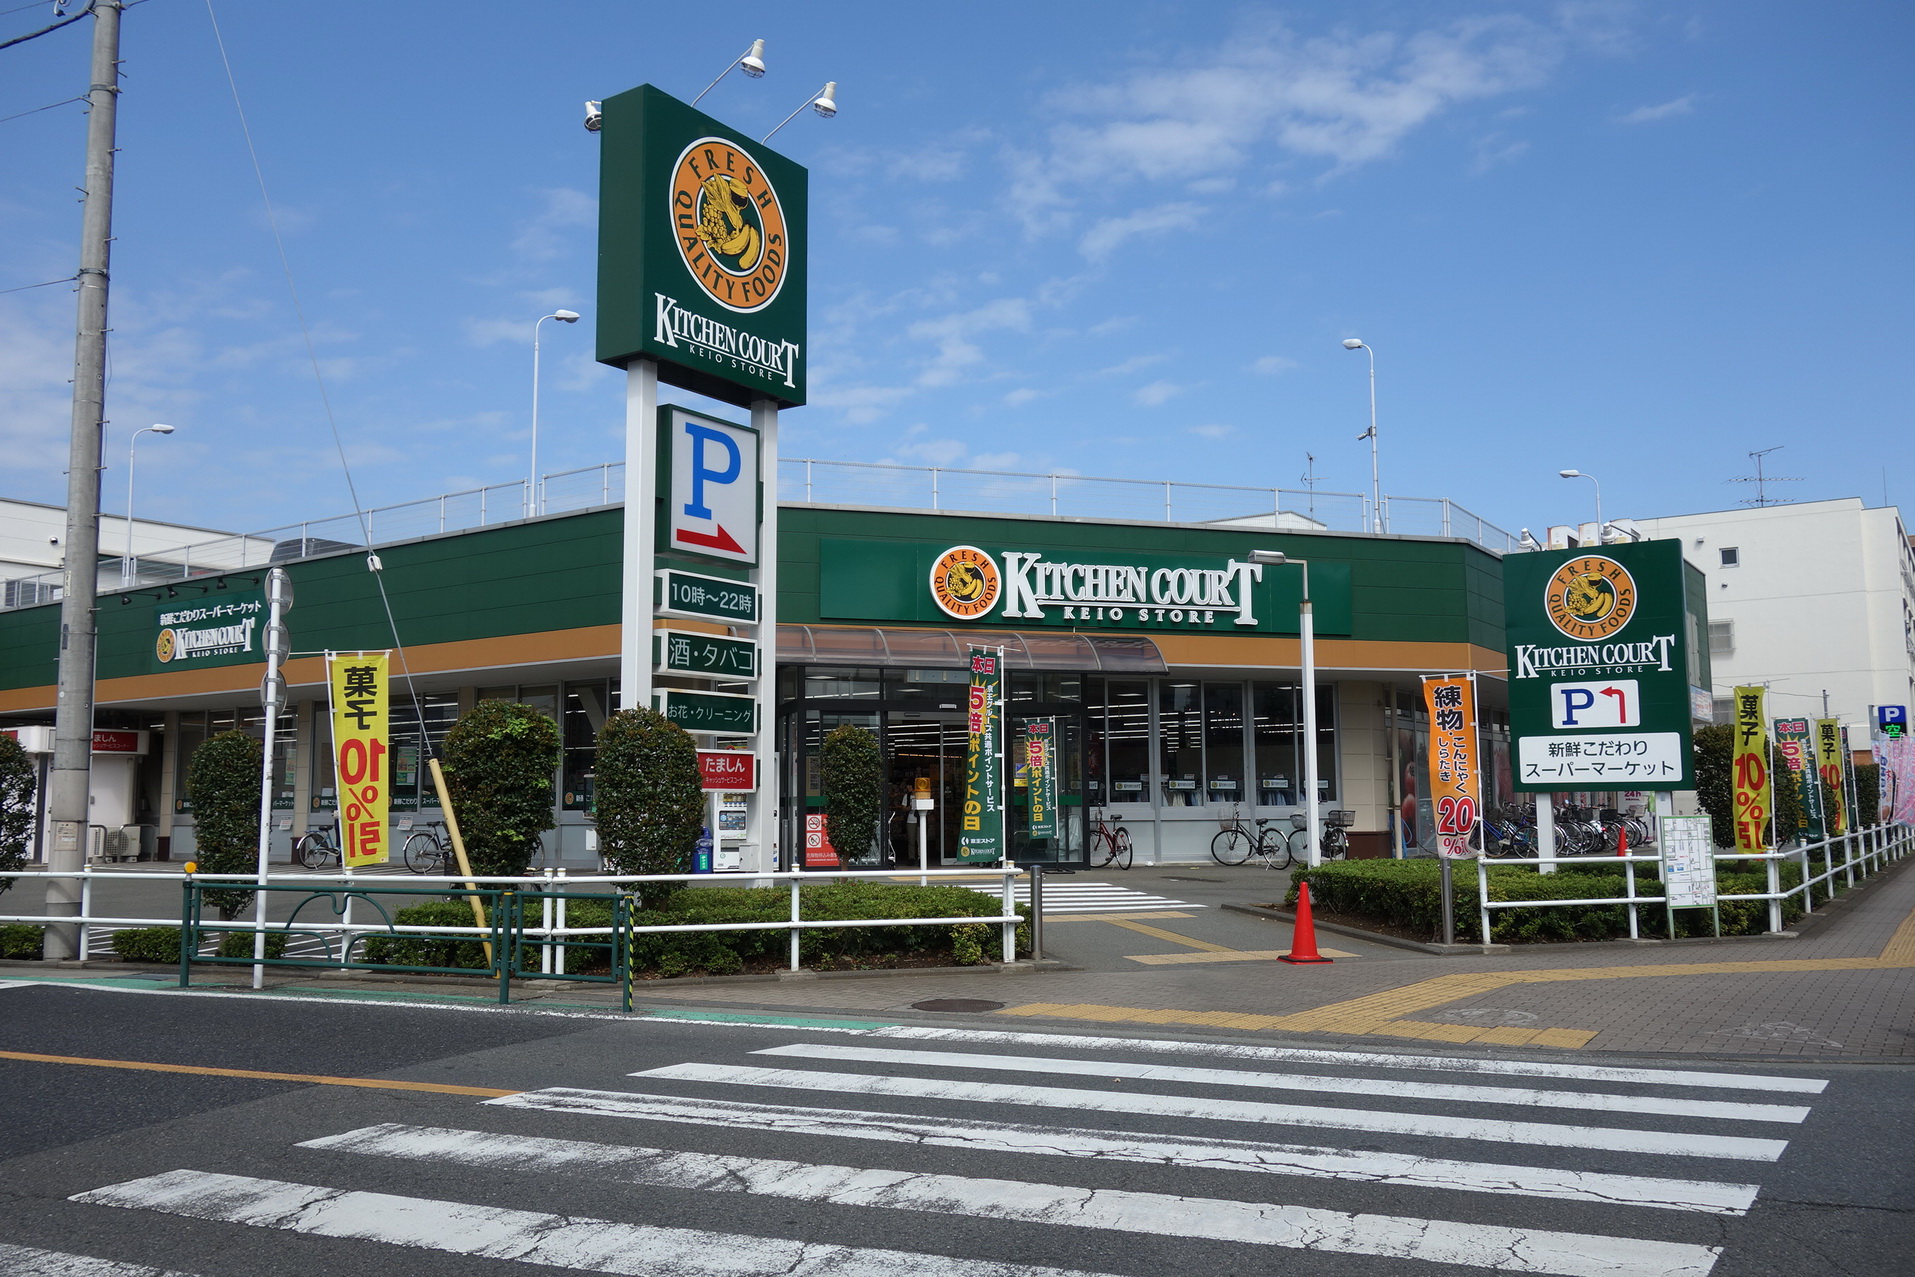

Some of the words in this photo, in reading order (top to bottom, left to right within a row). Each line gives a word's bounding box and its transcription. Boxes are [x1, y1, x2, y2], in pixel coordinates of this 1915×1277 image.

[689, 149, 772, 209] FRESH
[675, 190, 733, 300] QUALITY
[742, 233, 782, 303] FOODS
[653, 292, 739, 353] KITCHEN
[738, 330, 799, 389] COURT
[689, 344, 723, 364] KEIO
[731, 358, 773, 381] STORE
[683, 421, 741, 521] P
[940, 550, 990, 570] FRESH
[1557, 560, 1621, 585] FRESH
[934, 576, 970, 615] QUALITY
[973, 576, 997, 614] FOODS
[1000, 551, 1149, 619] KITCHEN
[1150, 557, 1263, 626] COURT
[1063, 606, 1124, 622] KEIO
[1138, 608, 1215, 624] STORE
[1547, 593, 1596, 637] QUALITY
[1600, 588, 1632, 634] FOODS
[174, 628, 218, 660] KITCHEN
[217, 617, 256, 652] COURT
[191, 650, 211, 658] KEIO
[213, 647, 239, 656] STORE
[669, 637, 754, 672] 酒・タバコ
[1514, 644, 1601, 679] KITCHEN
[1602, 634, 1676, 673] COURT
[970, 655, 996, 676] 本日
[1550, 668, 1586, 677] KEIO
[1595, 665, 1644, 675] STORE
[667, 703, 753, 724] お花・クリーニング
[1561, 688, 1595, 726] P
[1884, 707, 1900, 722] P
[94, 734, 117, 742] ましん
[1027, 723, 1049, 733] 本日
[1777, 721, 1806, 733] 本日
[1885, 724, 1901, 738] 空
[1437, 736, 1452, 783] しらたき
[1548, 739, 1648, 758] 新鮮こだわり
[705, 757, 746, 773] たましん
[1452, 736, 1468, 794] こんにゃく
[1525, 760, 1675, 778] スーパーマーケット
